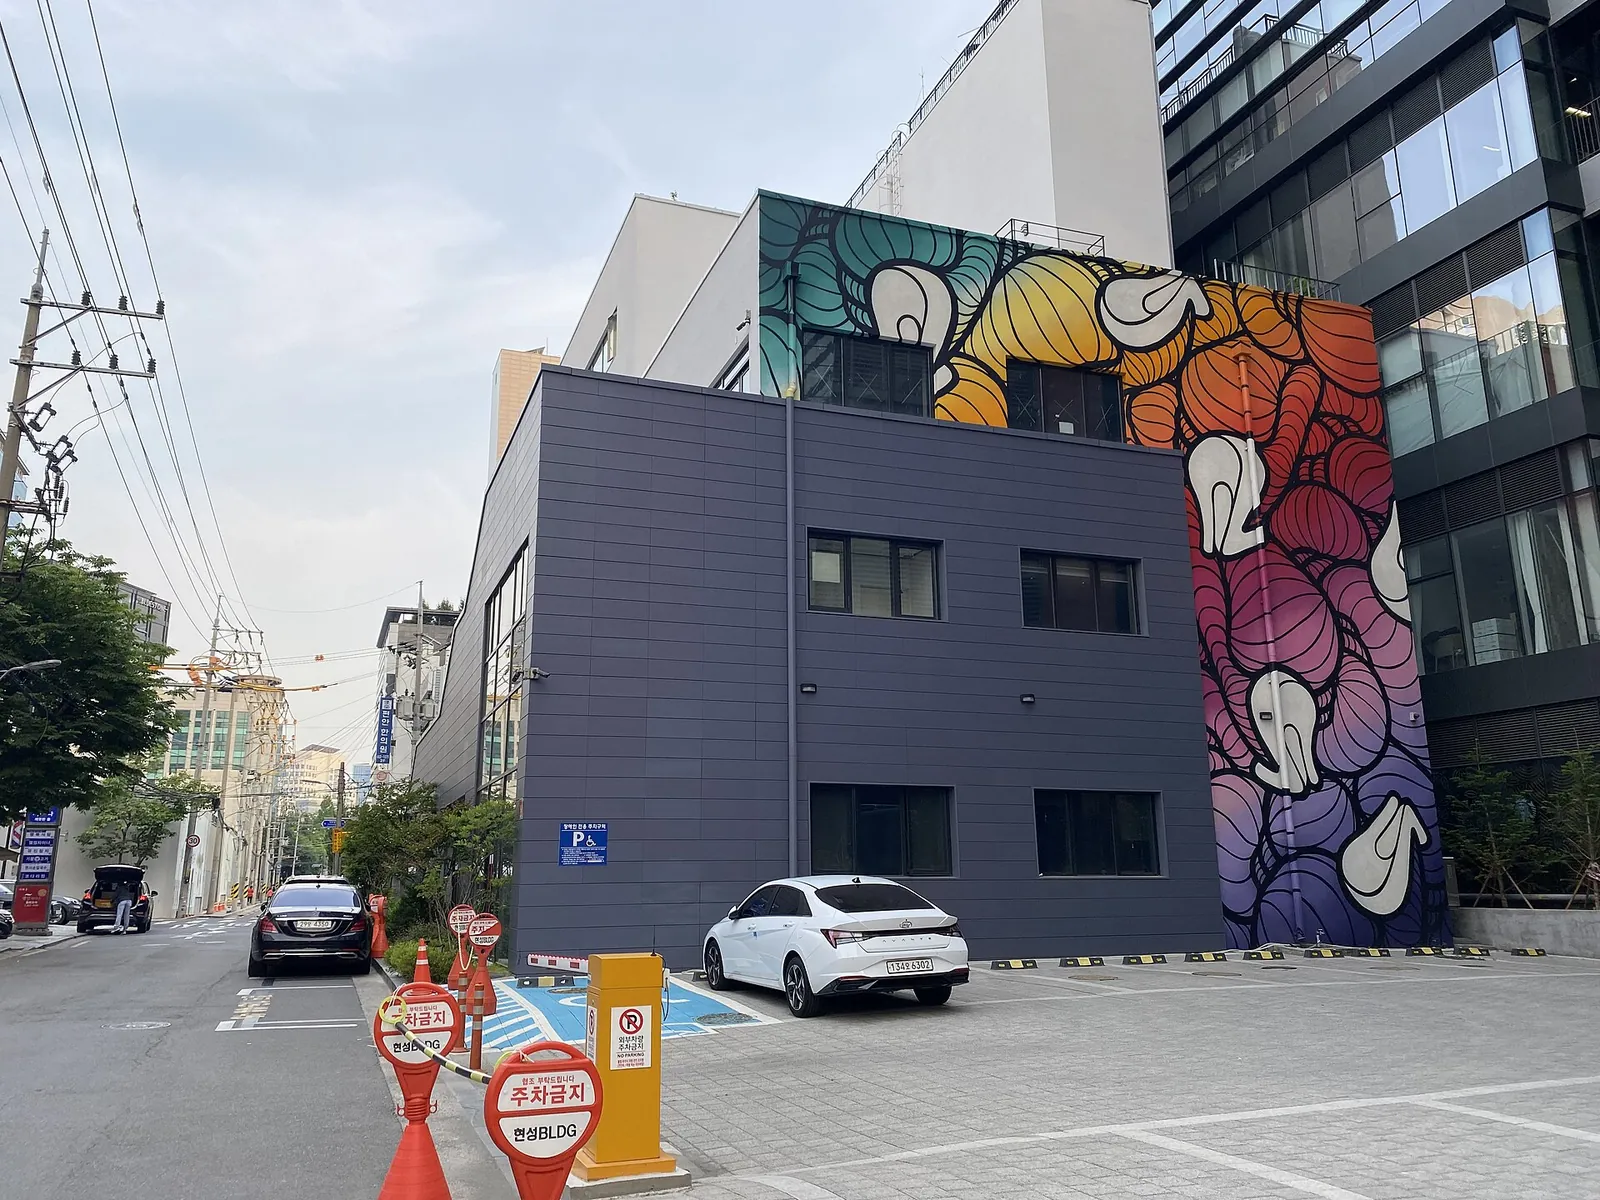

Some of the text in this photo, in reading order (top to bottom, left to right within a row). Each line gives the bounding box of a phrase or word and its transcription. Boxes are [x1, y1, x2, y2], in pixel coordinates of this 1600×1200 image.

[380, 728, 388, 754] 한의원
[188, 837, 198, 845] 30
[572, 832, 584, 846] P
[911, 961, 930, 970] 6302
[393, 1040, 440, 1052] 현성BDG
[538, 1075, 574, 1084] 부탁드립니다
[510, 1082, 584, 1106] 주차금지
[514, 1124, 576, 1142] 현성BLDG
